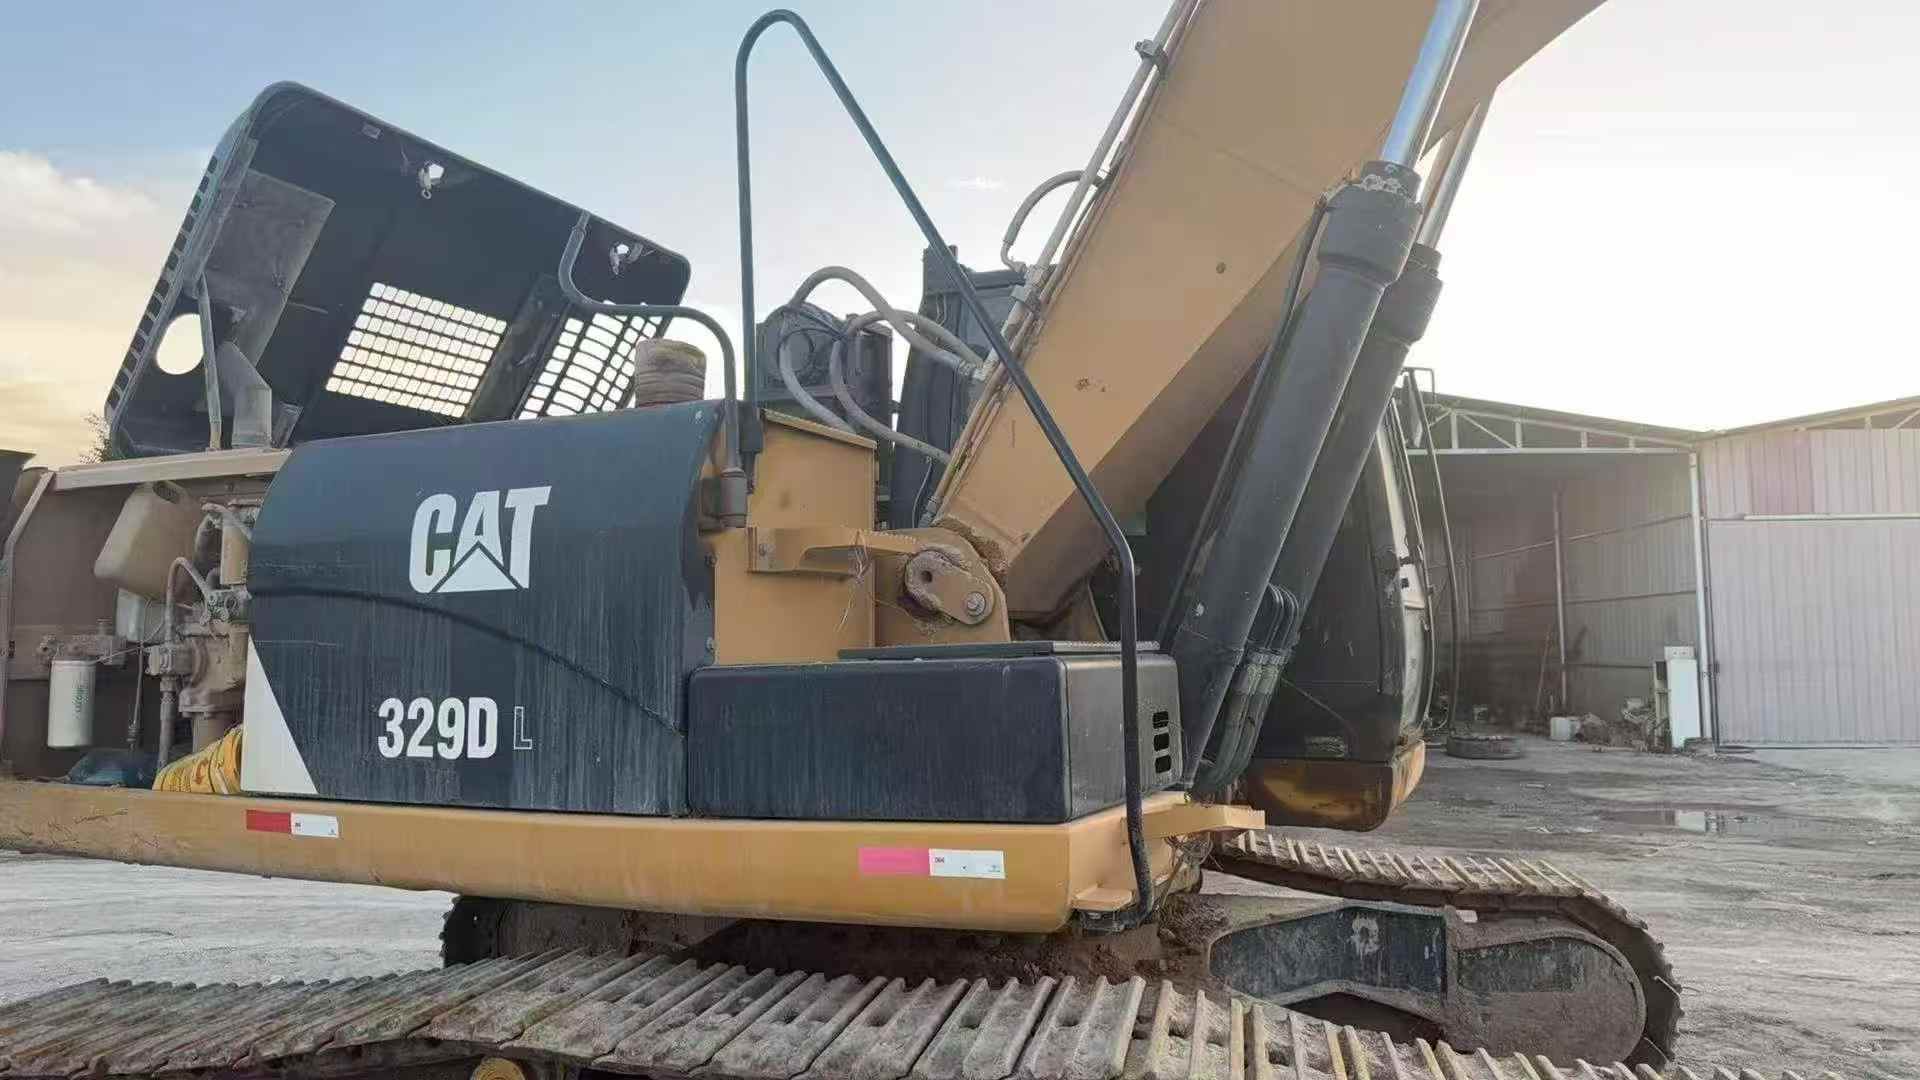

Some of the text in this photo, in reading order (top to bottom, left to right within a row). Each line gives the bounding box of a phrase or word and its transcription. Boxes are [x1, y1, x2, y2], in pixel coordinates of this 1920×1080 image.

[409, 486, 552, 594] CAT
[378, 697, 533, 760] 329D L
